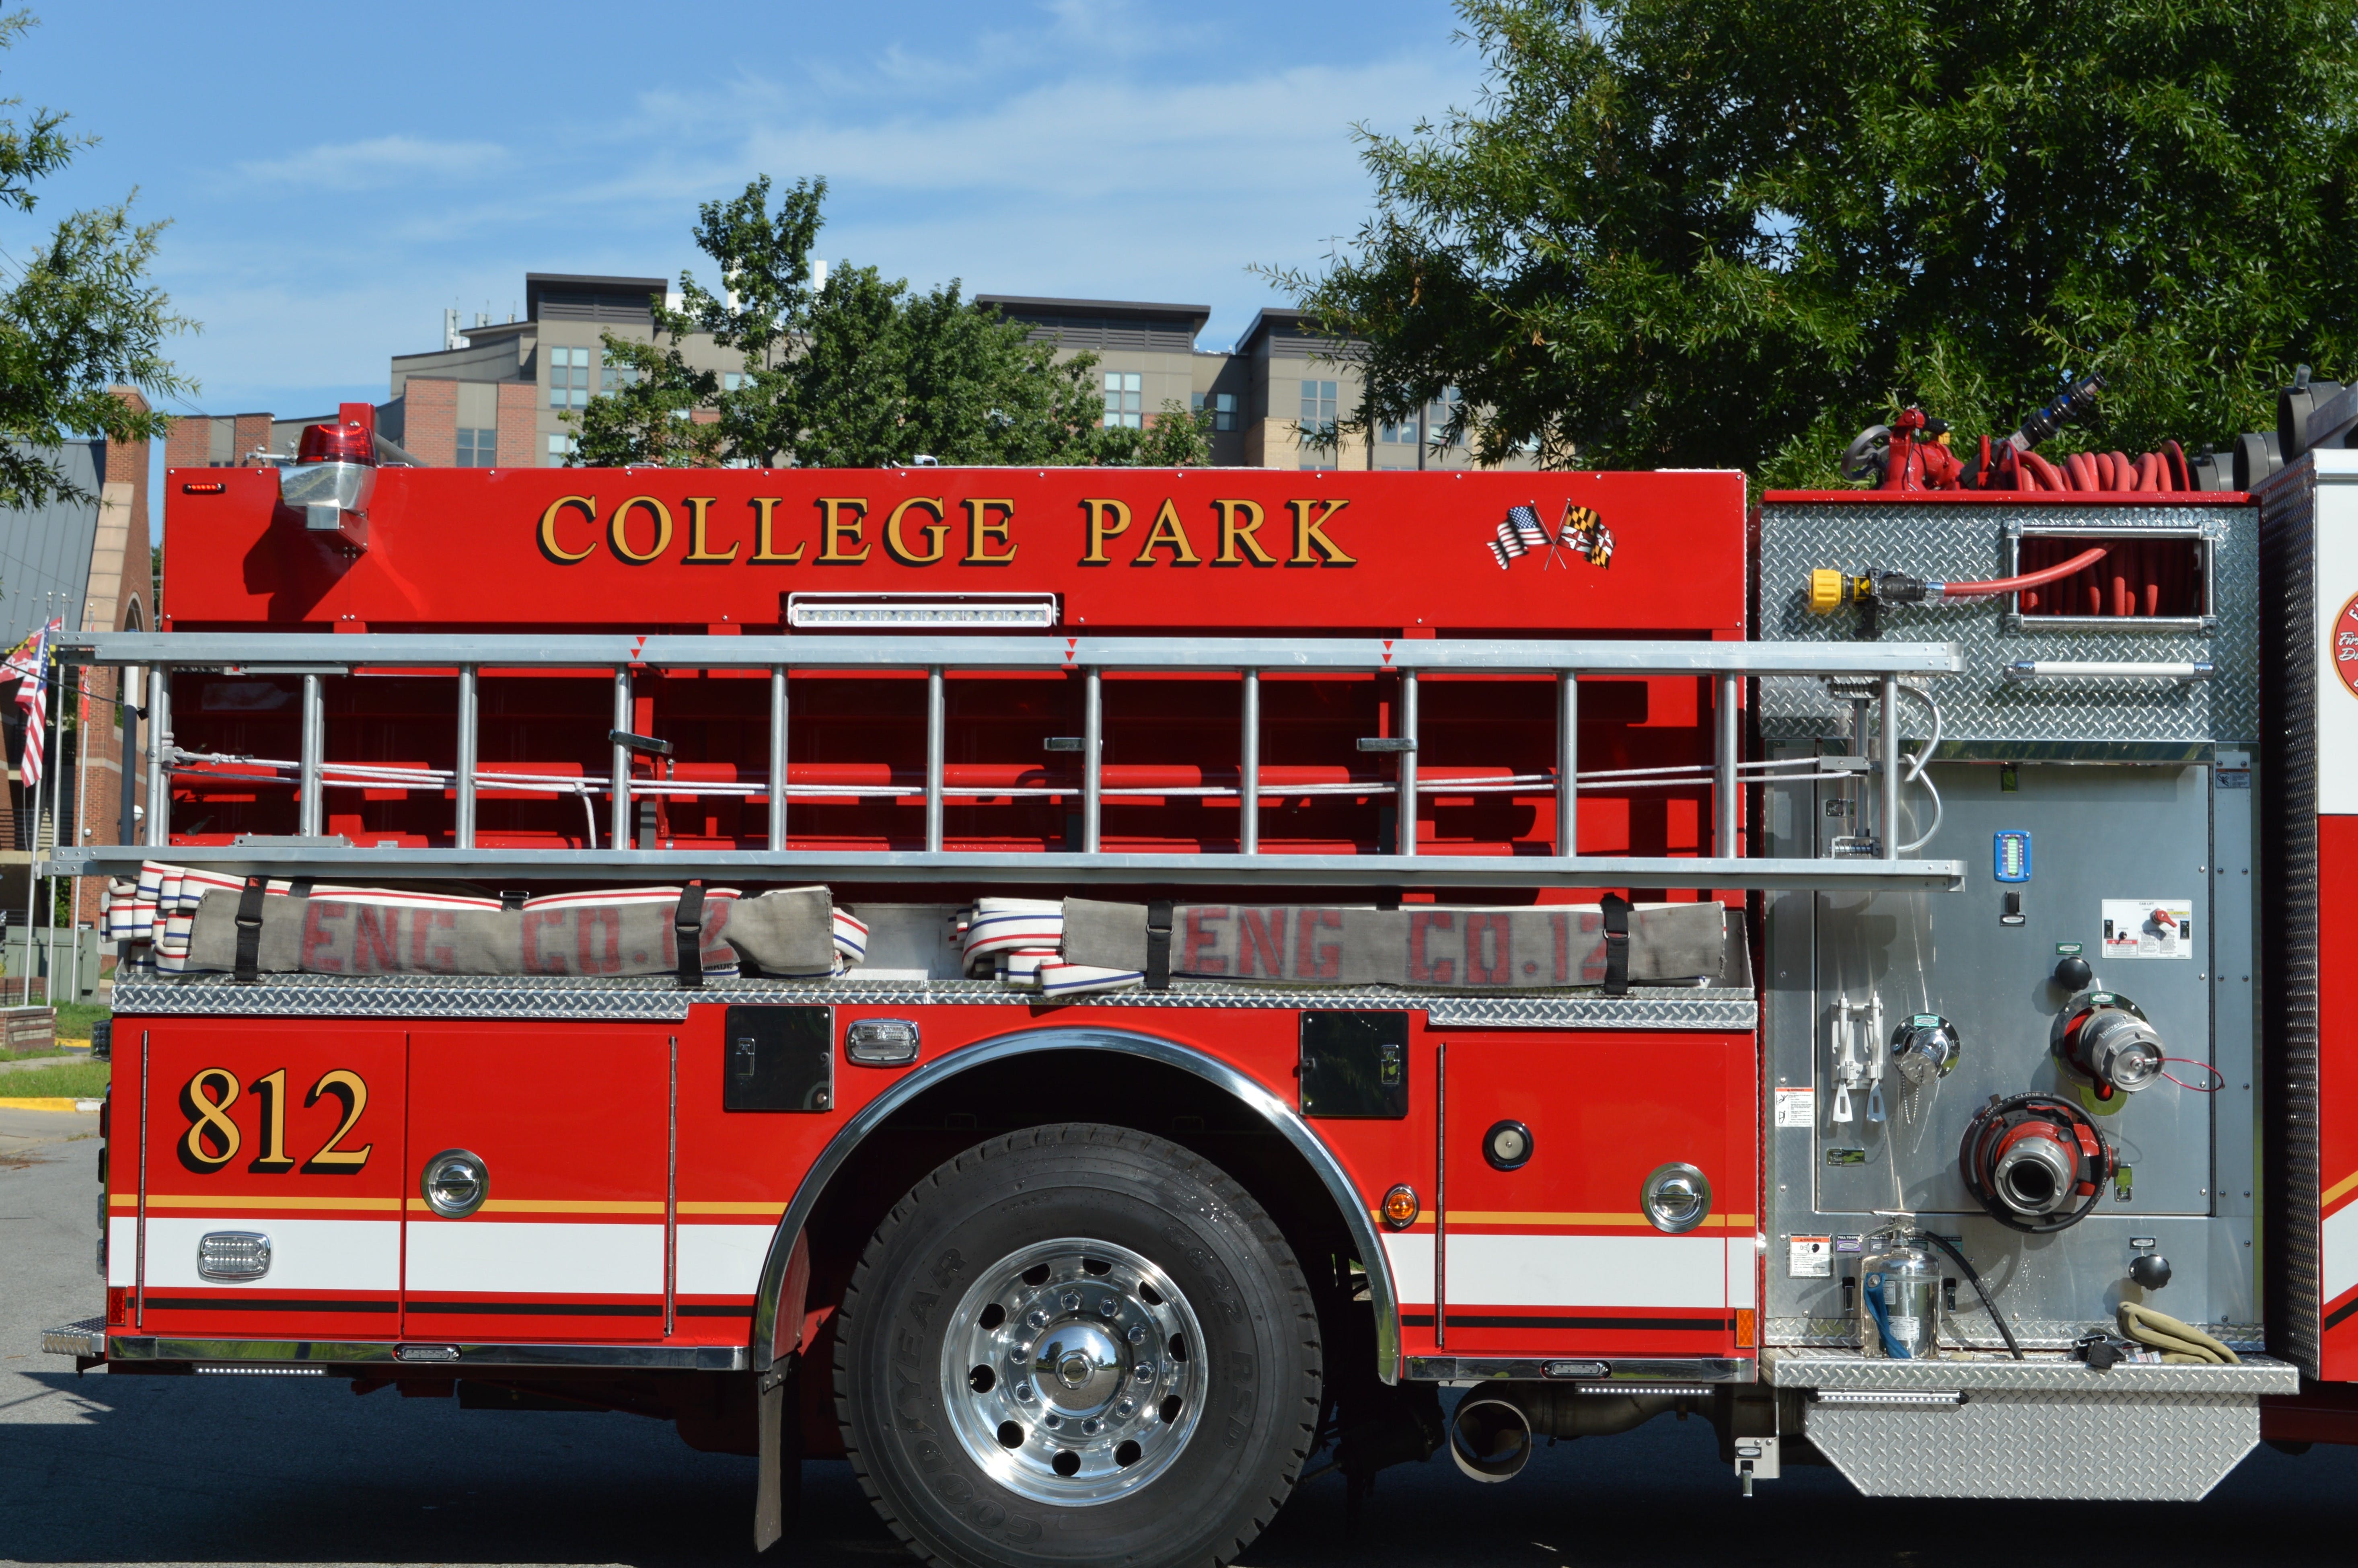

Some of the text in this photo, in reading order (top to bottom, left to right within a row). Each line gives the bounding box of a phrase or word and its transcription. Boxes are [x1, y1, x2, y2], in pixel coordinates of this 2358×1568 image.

[536, 494, 1358, 569] COLLEGE PARK
[302, 902, 457, 975] ENG
[1183, 906, 1343, 980] ENG
[177, 1067, 373, 1175] 812
[1985, 1101, 2003, 1118] OPEN
[895, 1248, 1043, 1545] GOODYEAR
[1224, 1349, 1254, 1449] RSD
